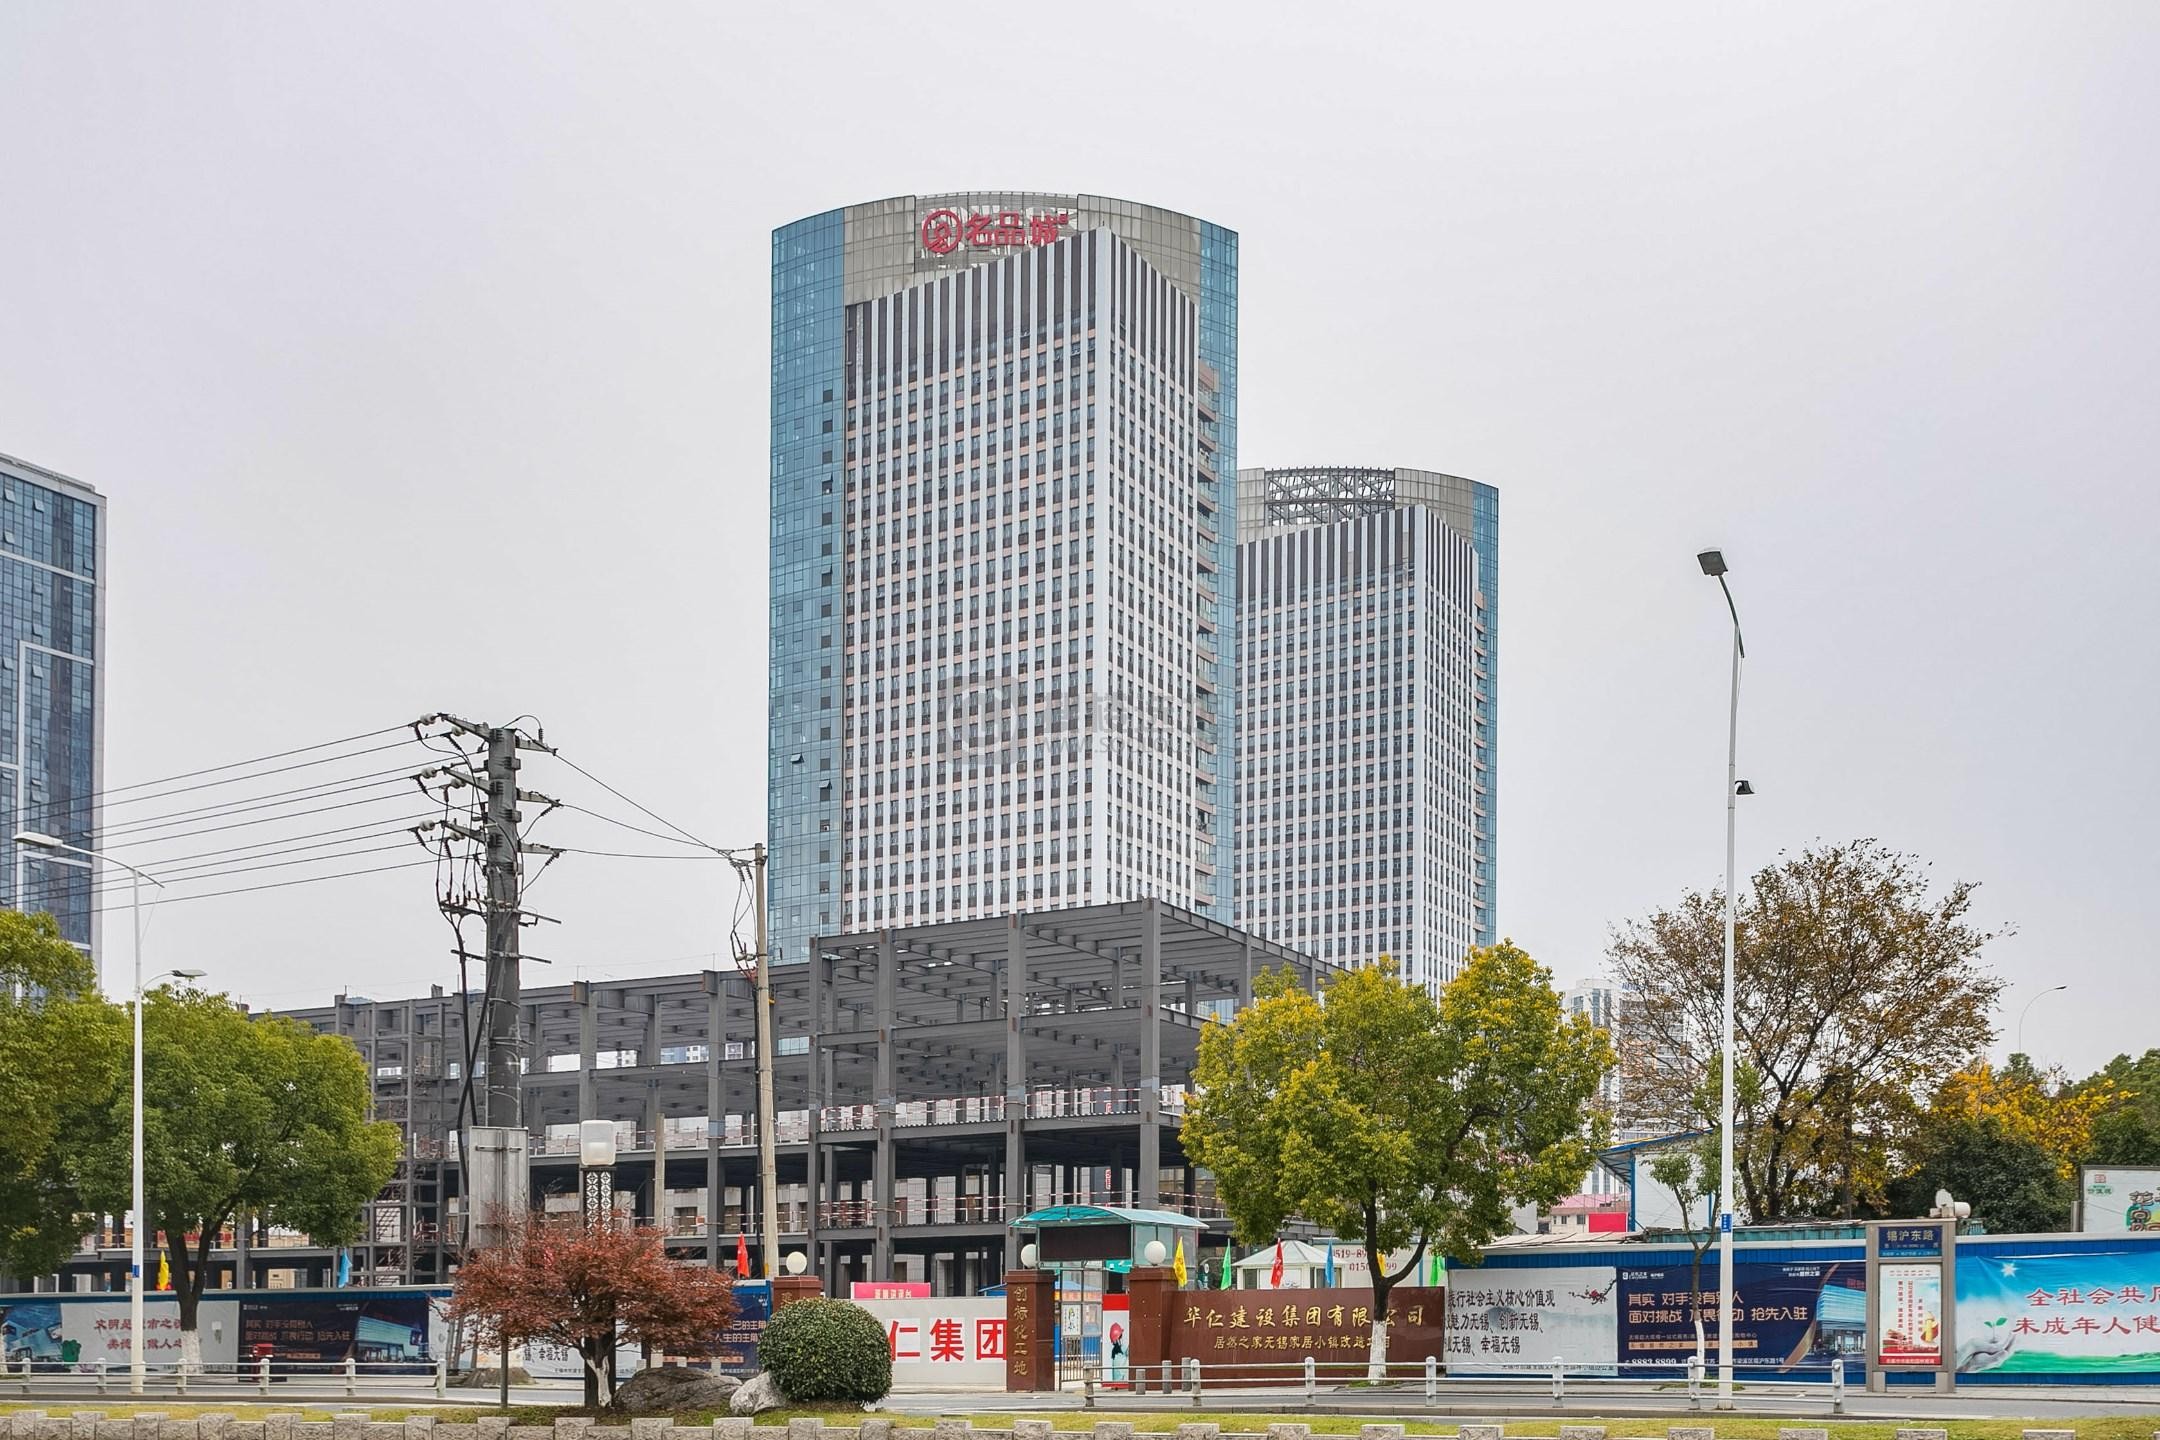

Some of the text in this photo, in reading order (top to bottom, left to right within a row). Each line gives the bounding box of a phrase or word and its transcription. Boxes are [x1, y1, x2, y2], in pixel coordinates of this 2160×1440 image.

[1886, 1230, 1935, 1242] 锡沪东路
[1628, 1293, 1655, 1306] 其实
[1628, 1310, 1683, 1324] 面对挑战
[1751, 1307, 1808, 1321] 抢先入驻
[1214, 1335, 1392, 1350] 居然之家无锡家居小镇改造目
